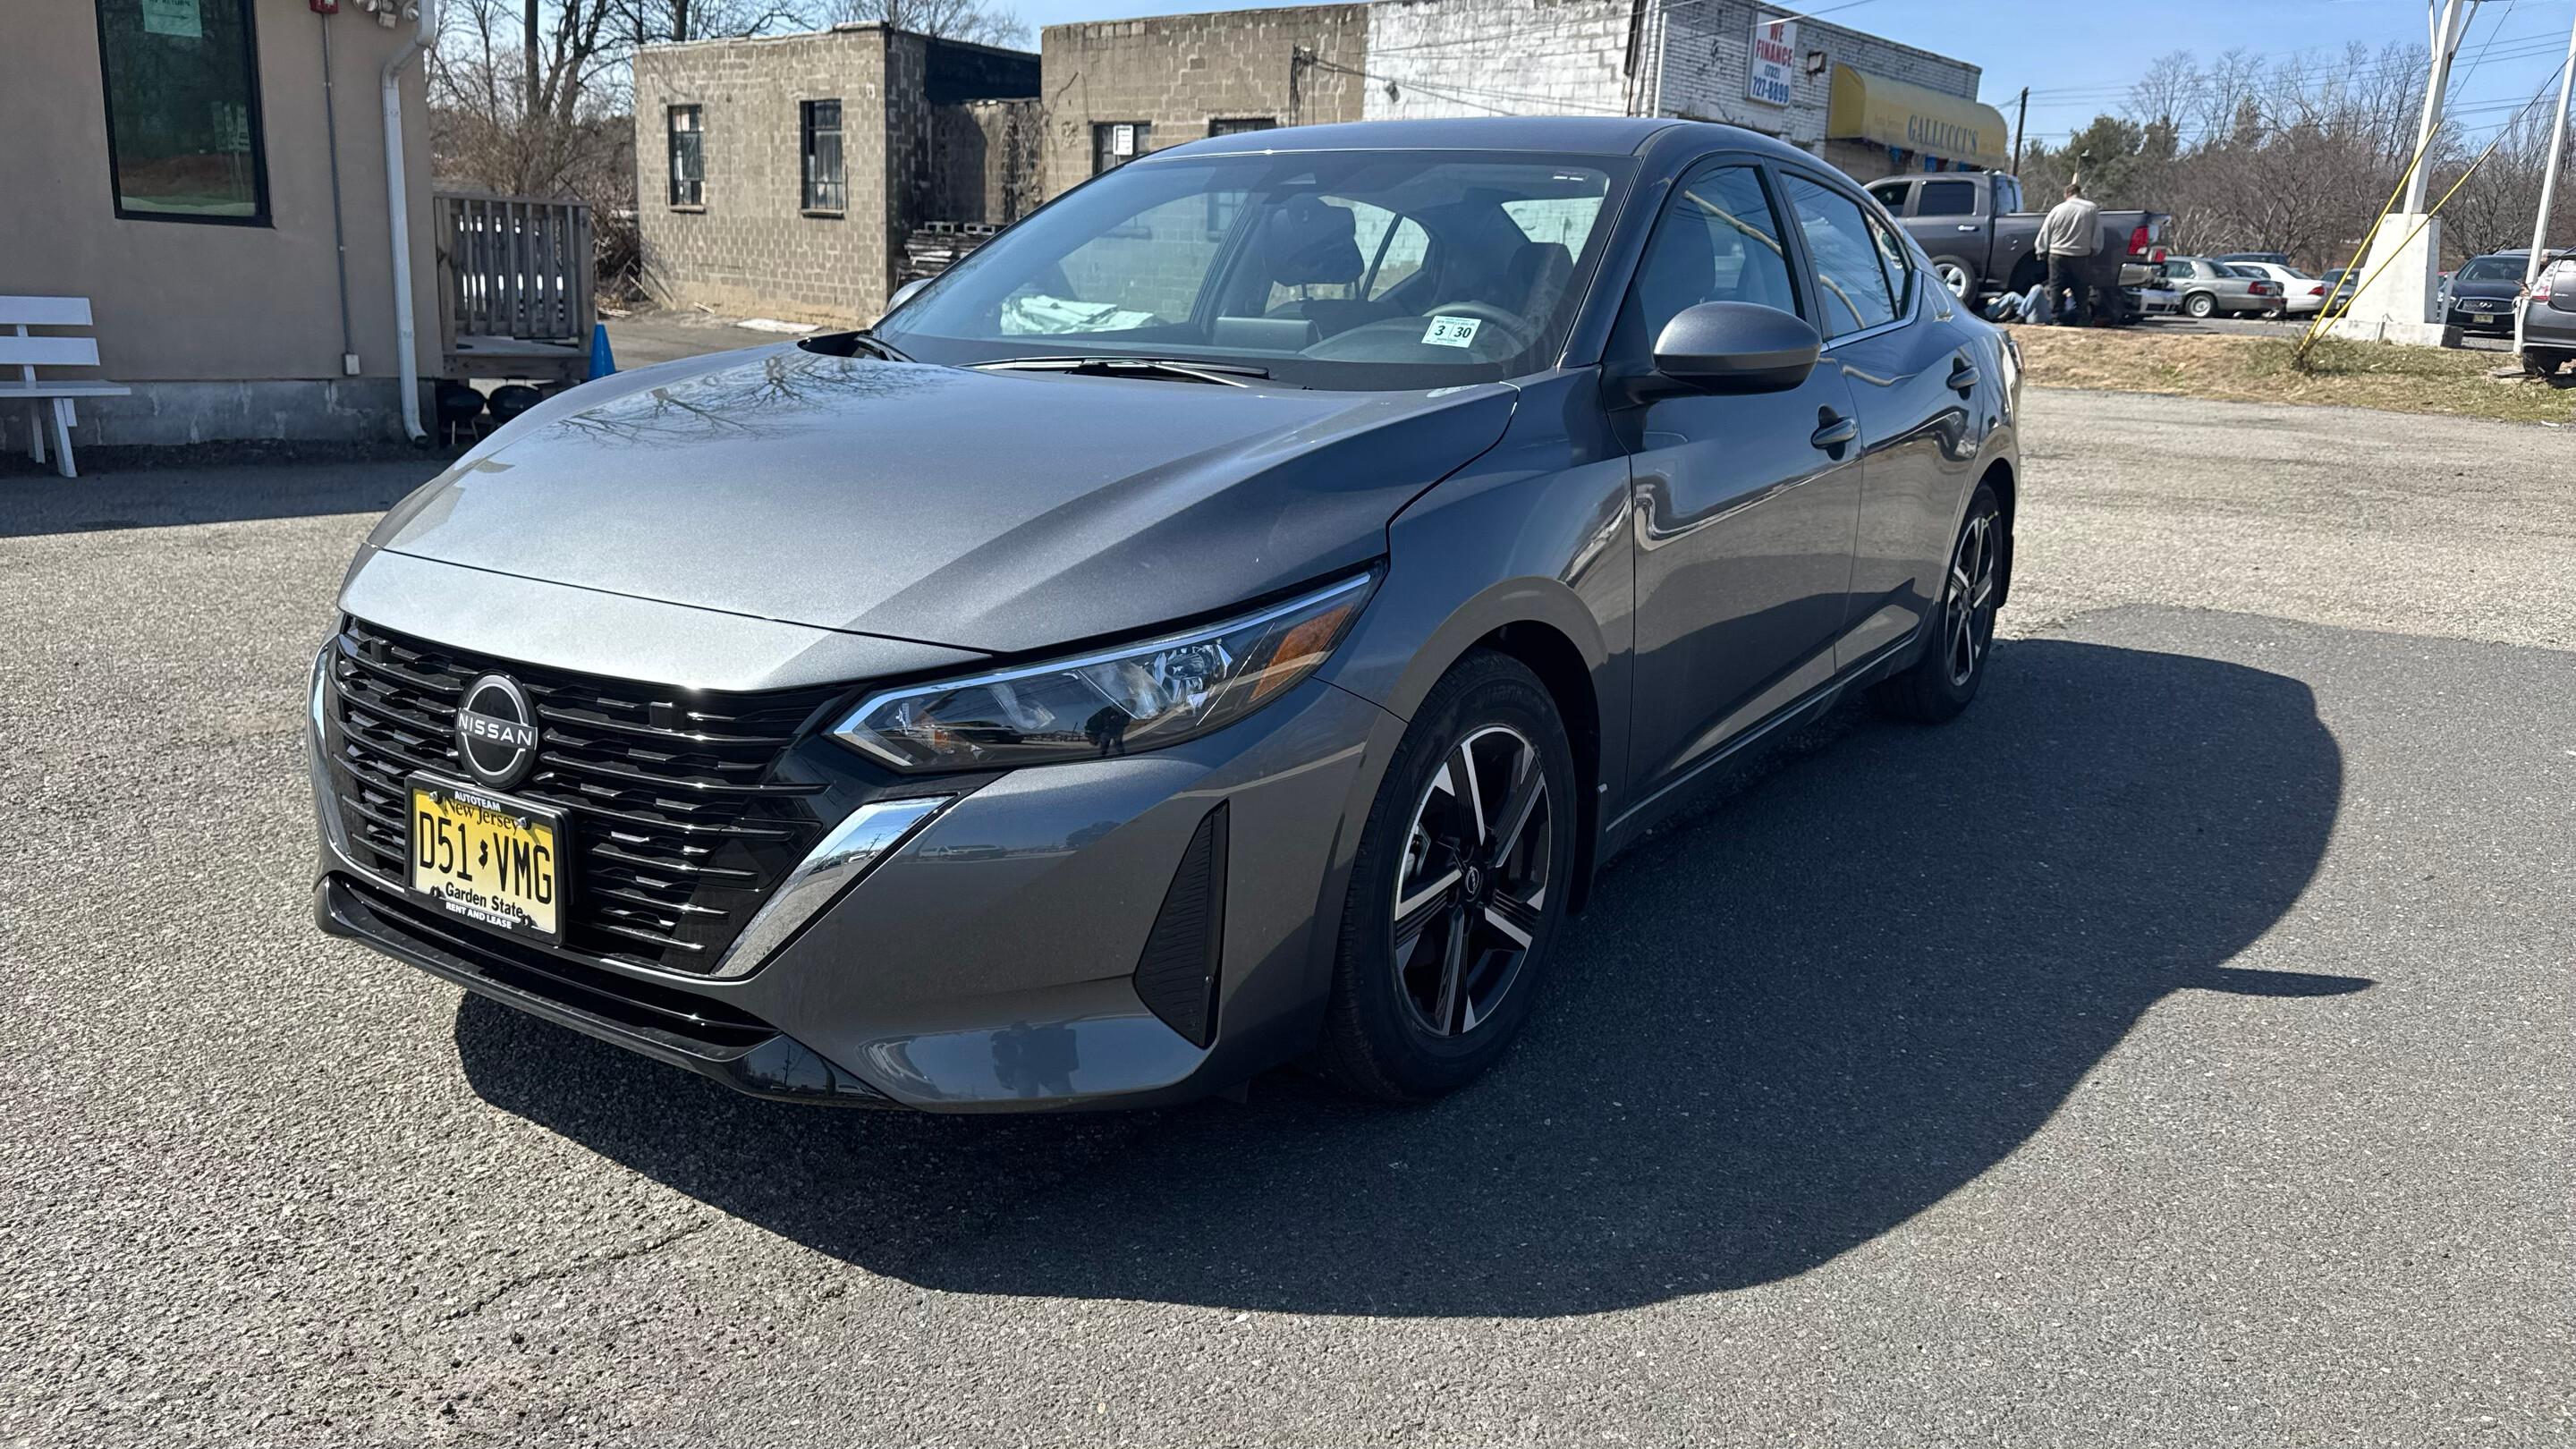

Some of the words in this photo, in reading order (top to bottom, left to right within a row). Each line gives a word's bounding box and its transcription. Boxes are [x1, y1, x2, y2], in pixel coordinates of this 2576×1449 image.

[1770, 23, 1784, 43] WE
[1756, 39, 1793, 67] FINANCE
[1435, 325, 1445, 336] 3
[1453, 326, 1472, 338] 30
[459, 712, 532, 746] NISSAN
[454, 791, 501, 812] AUTOTEAM
[445, 798, 475, 818] New
[477, 807, 518, 835] Jersey
[419, 810, 472, 881] D51
[493, 832, 552, 904] VMG
[445, 882, 487, 908] Garden
[491, 895, 523, 919] State
[445, 902, 467, 915] RENT
[467, 909, 486, 921] AND
[487, 914, 513, 929] LEASE
